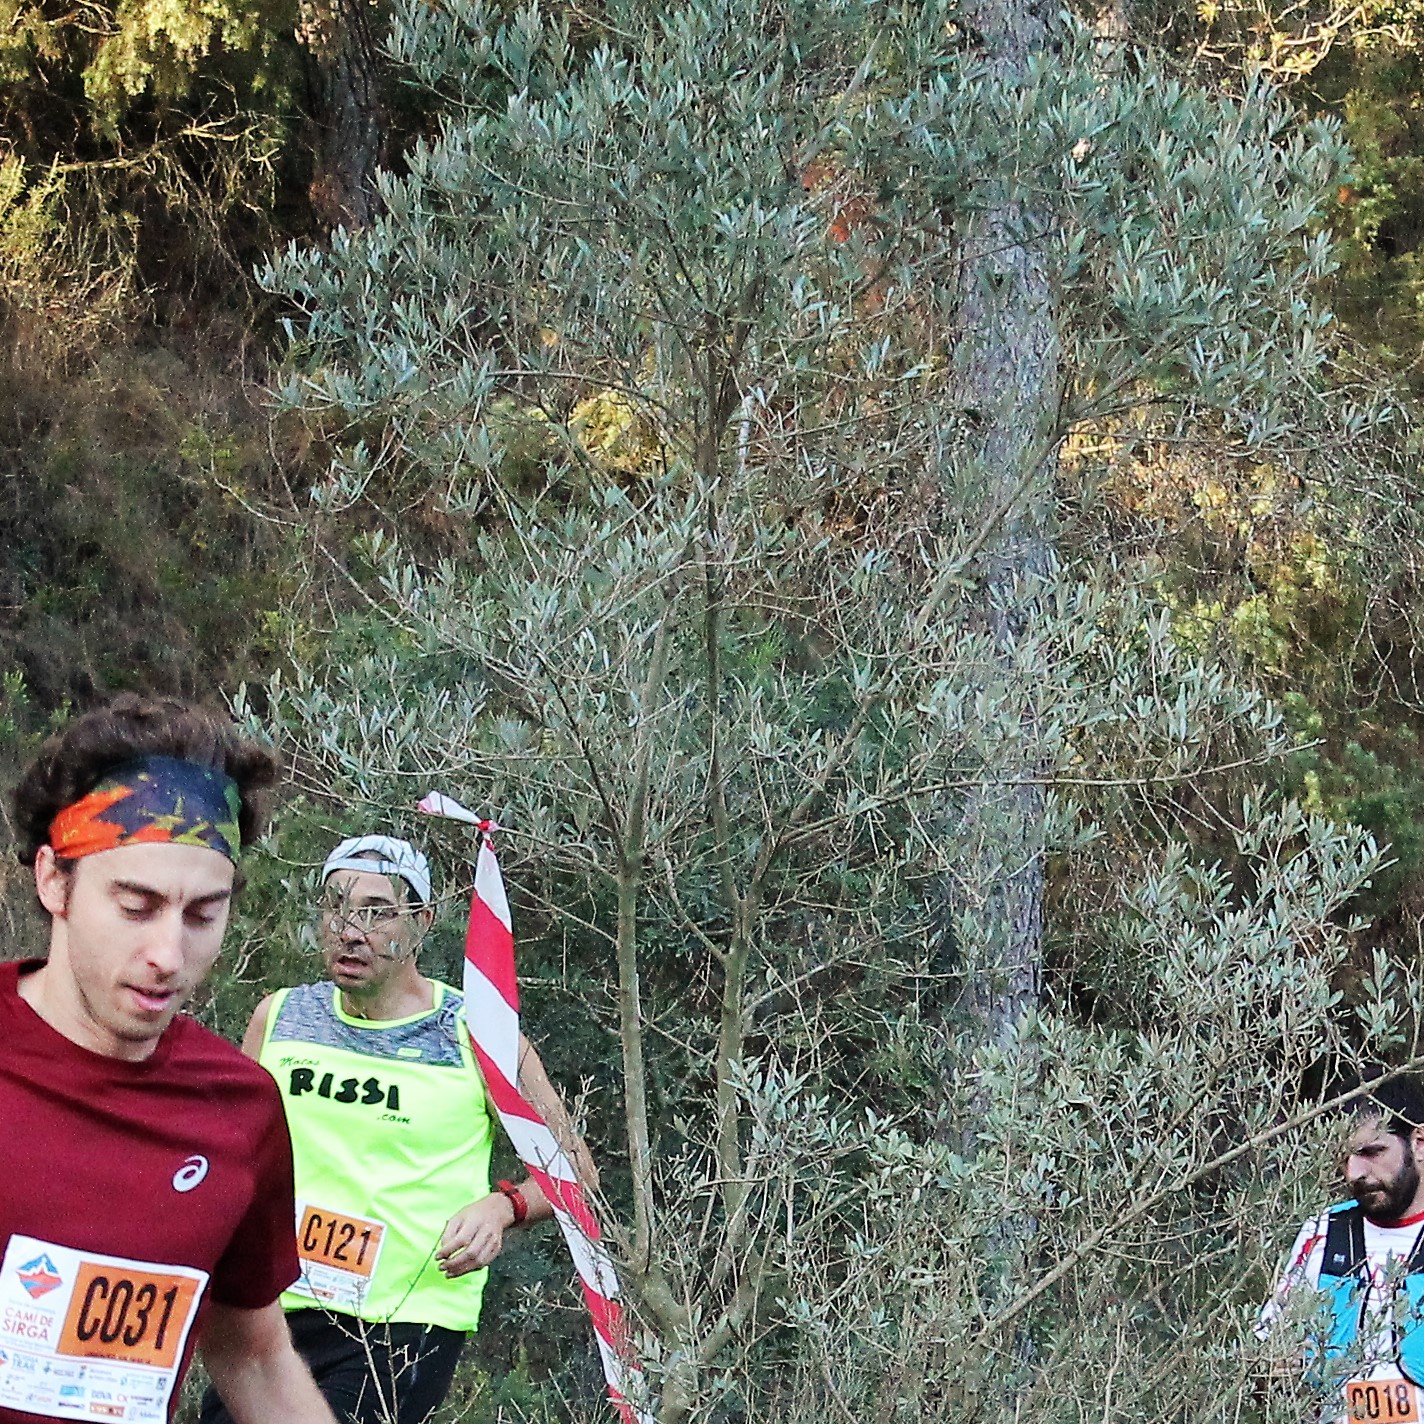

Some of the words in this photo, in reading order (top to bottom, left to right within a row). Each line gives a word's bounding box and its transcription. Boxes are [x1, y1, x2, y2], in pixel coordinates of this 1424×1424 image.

[289, 1067, 400, 1111] RISSI
[303, 1214, 372, 1265] C121
[2, 1318, 48, 1342] SIRGA
[39, 1315, 54, 1328] DE
[77, 1276, 179, 1350] C031
